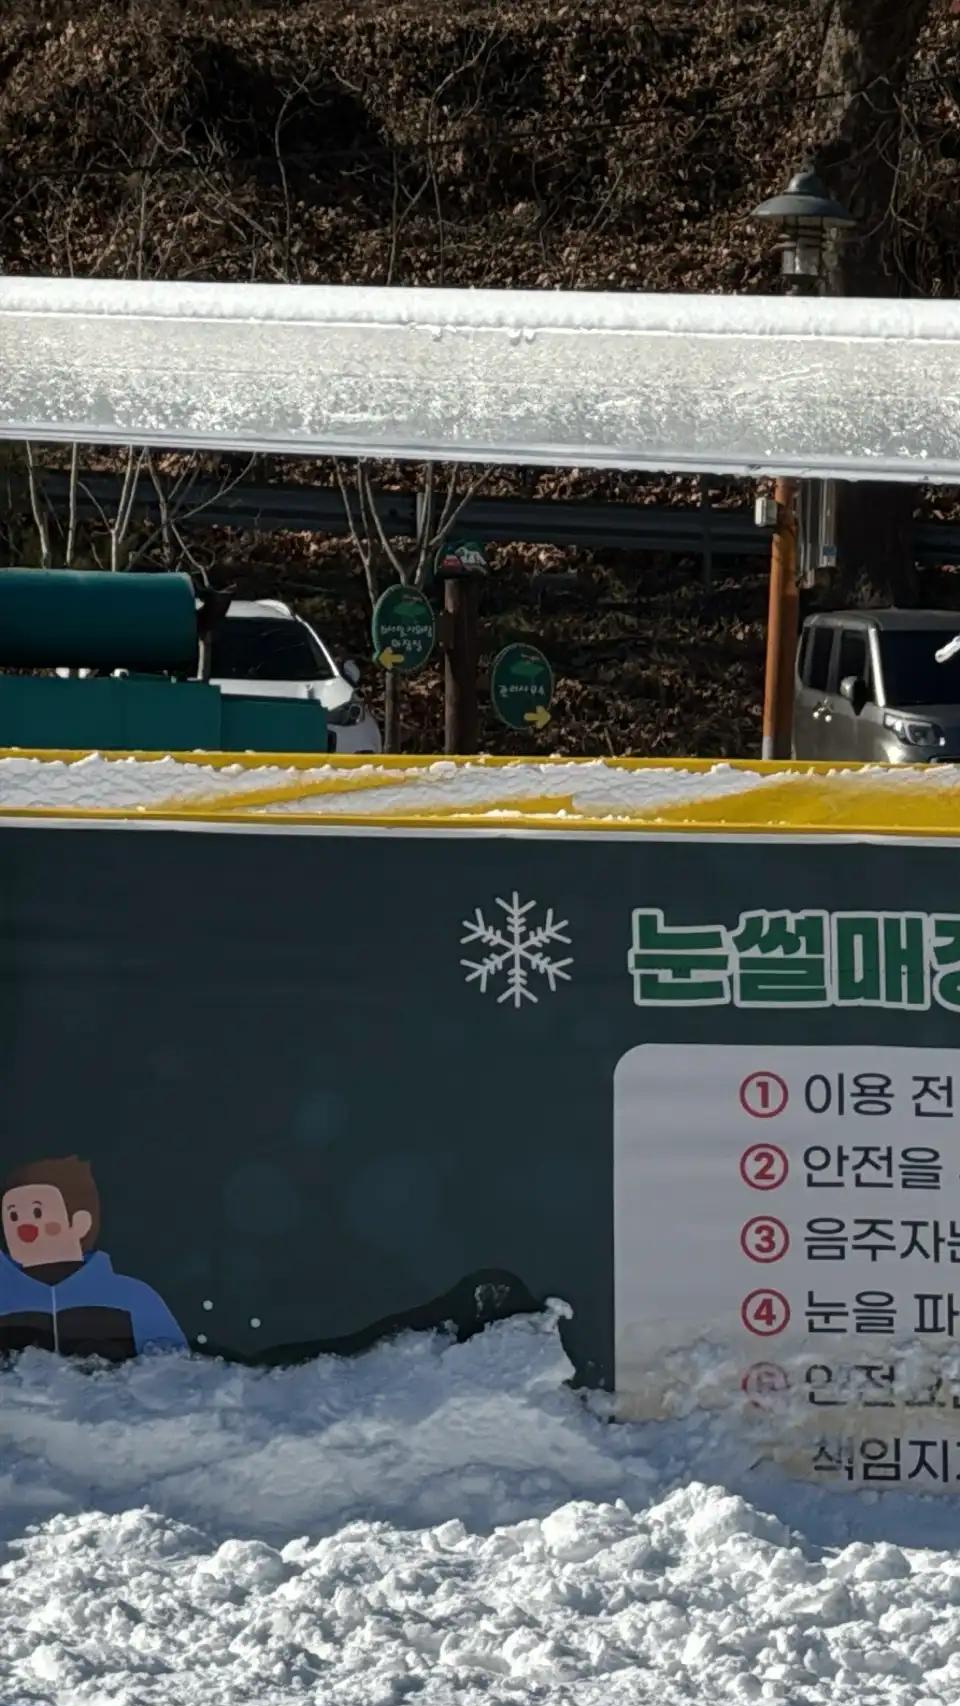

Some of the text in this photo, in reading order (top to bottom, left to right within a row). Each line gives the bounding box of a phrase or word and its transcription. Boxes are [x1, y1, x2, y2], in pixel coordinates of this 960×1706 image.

[804, 1072, 896, 1117] 이용
[911, 1075, 955, 1119] 전
[802, 1145, 943, 1191] 안전을
[804, 1290, 898, 1335] 눈을
